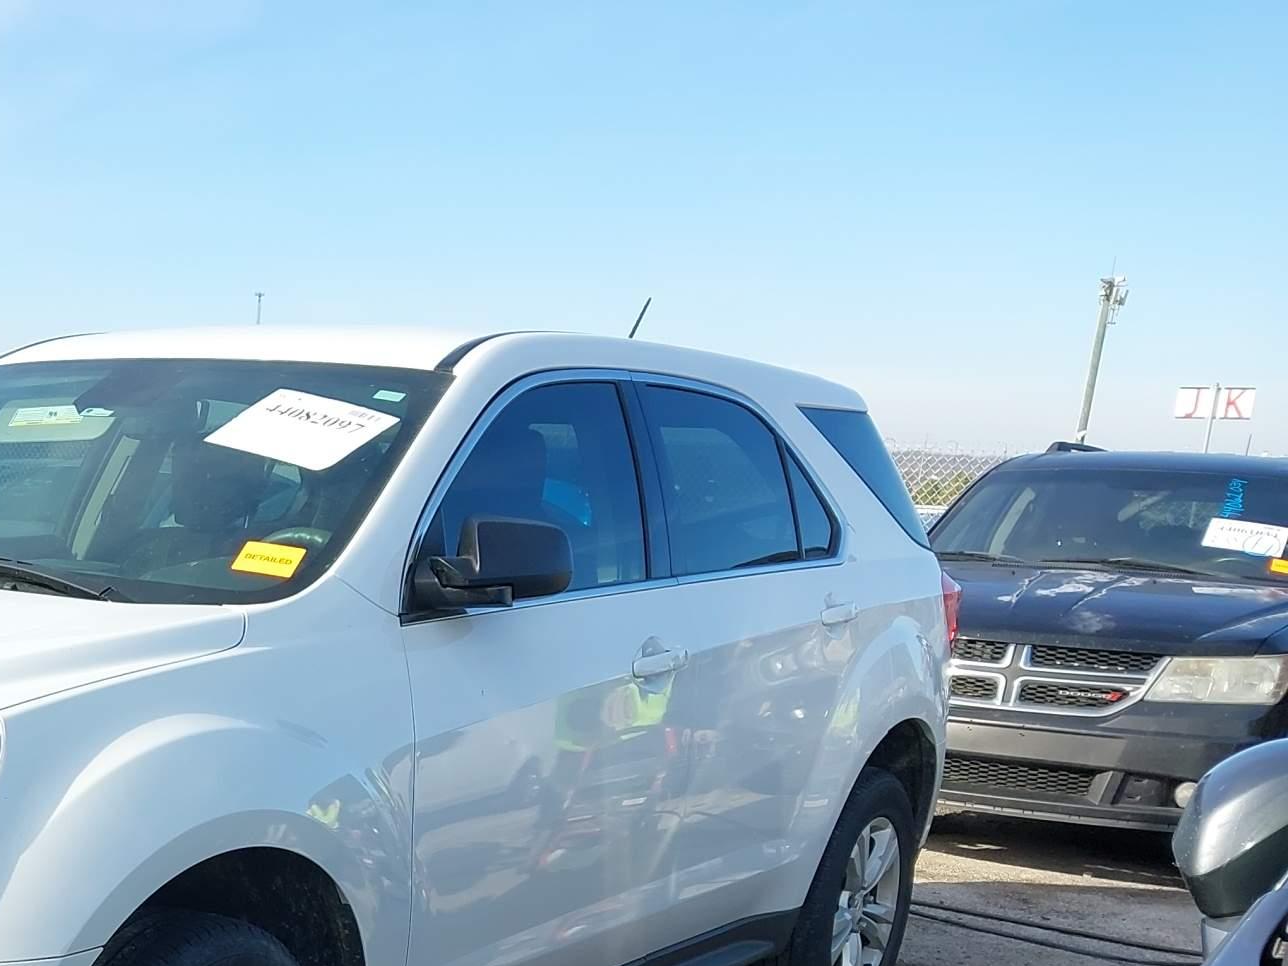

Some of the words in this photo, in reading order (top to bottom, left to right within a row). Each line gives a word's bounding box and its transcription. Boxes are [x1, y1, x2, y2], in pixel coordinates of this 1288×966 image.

[1184, 388, 1201, 418] J
[1223, 388, 1246, 419] K
[266, 404, 365, 433] 44082097
[244, 553, 293, 565] DETAILED
[1058, 689, 1112, 699] DODGE
